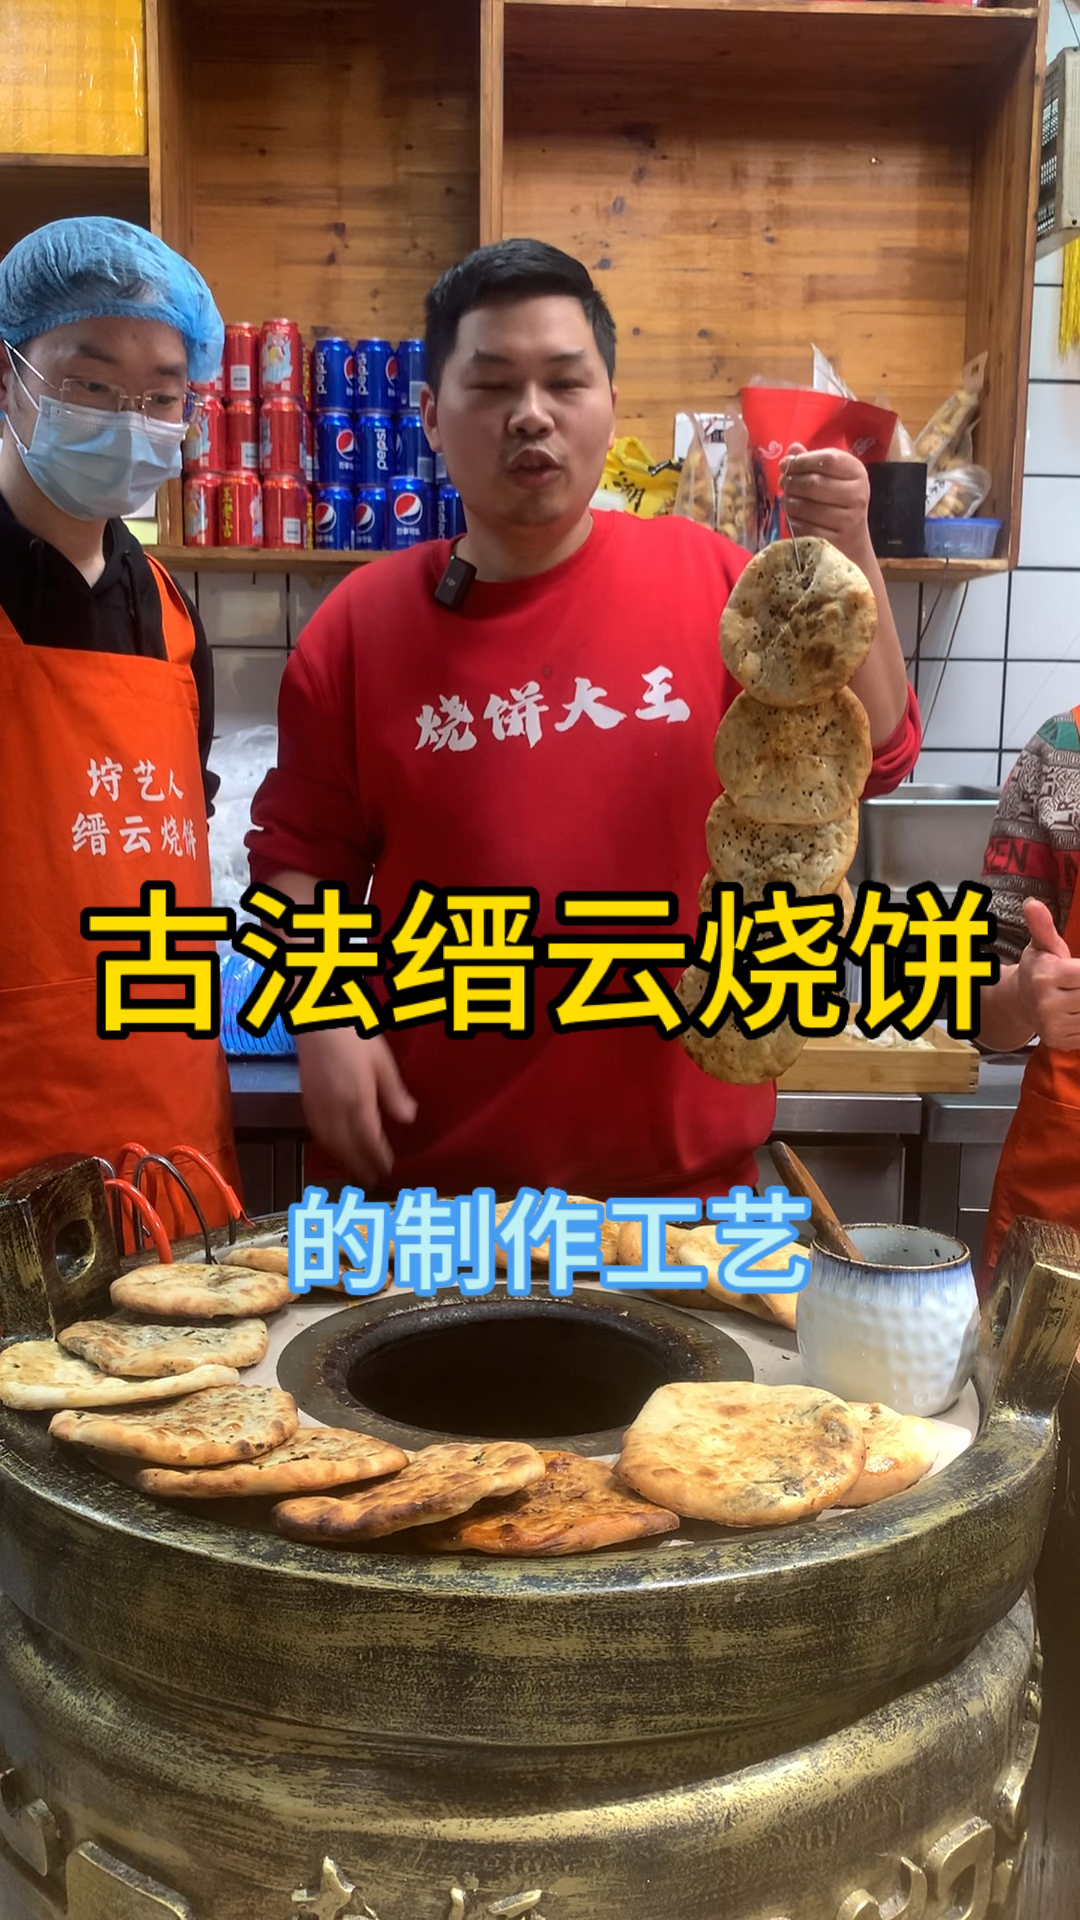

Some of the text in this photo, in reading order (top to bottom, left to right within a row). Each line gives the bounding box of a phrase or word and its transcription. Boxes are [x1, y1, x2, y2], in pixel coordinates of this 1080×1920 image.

[316, 352, 327, 395] pepsi
[358, 352, 369, 396] pepsi
[374, 428, 389, 471] pepsi
[415, 665, 691, 752] 烧饼大王
[71, 812, 197, 860] 缙云烧饼
